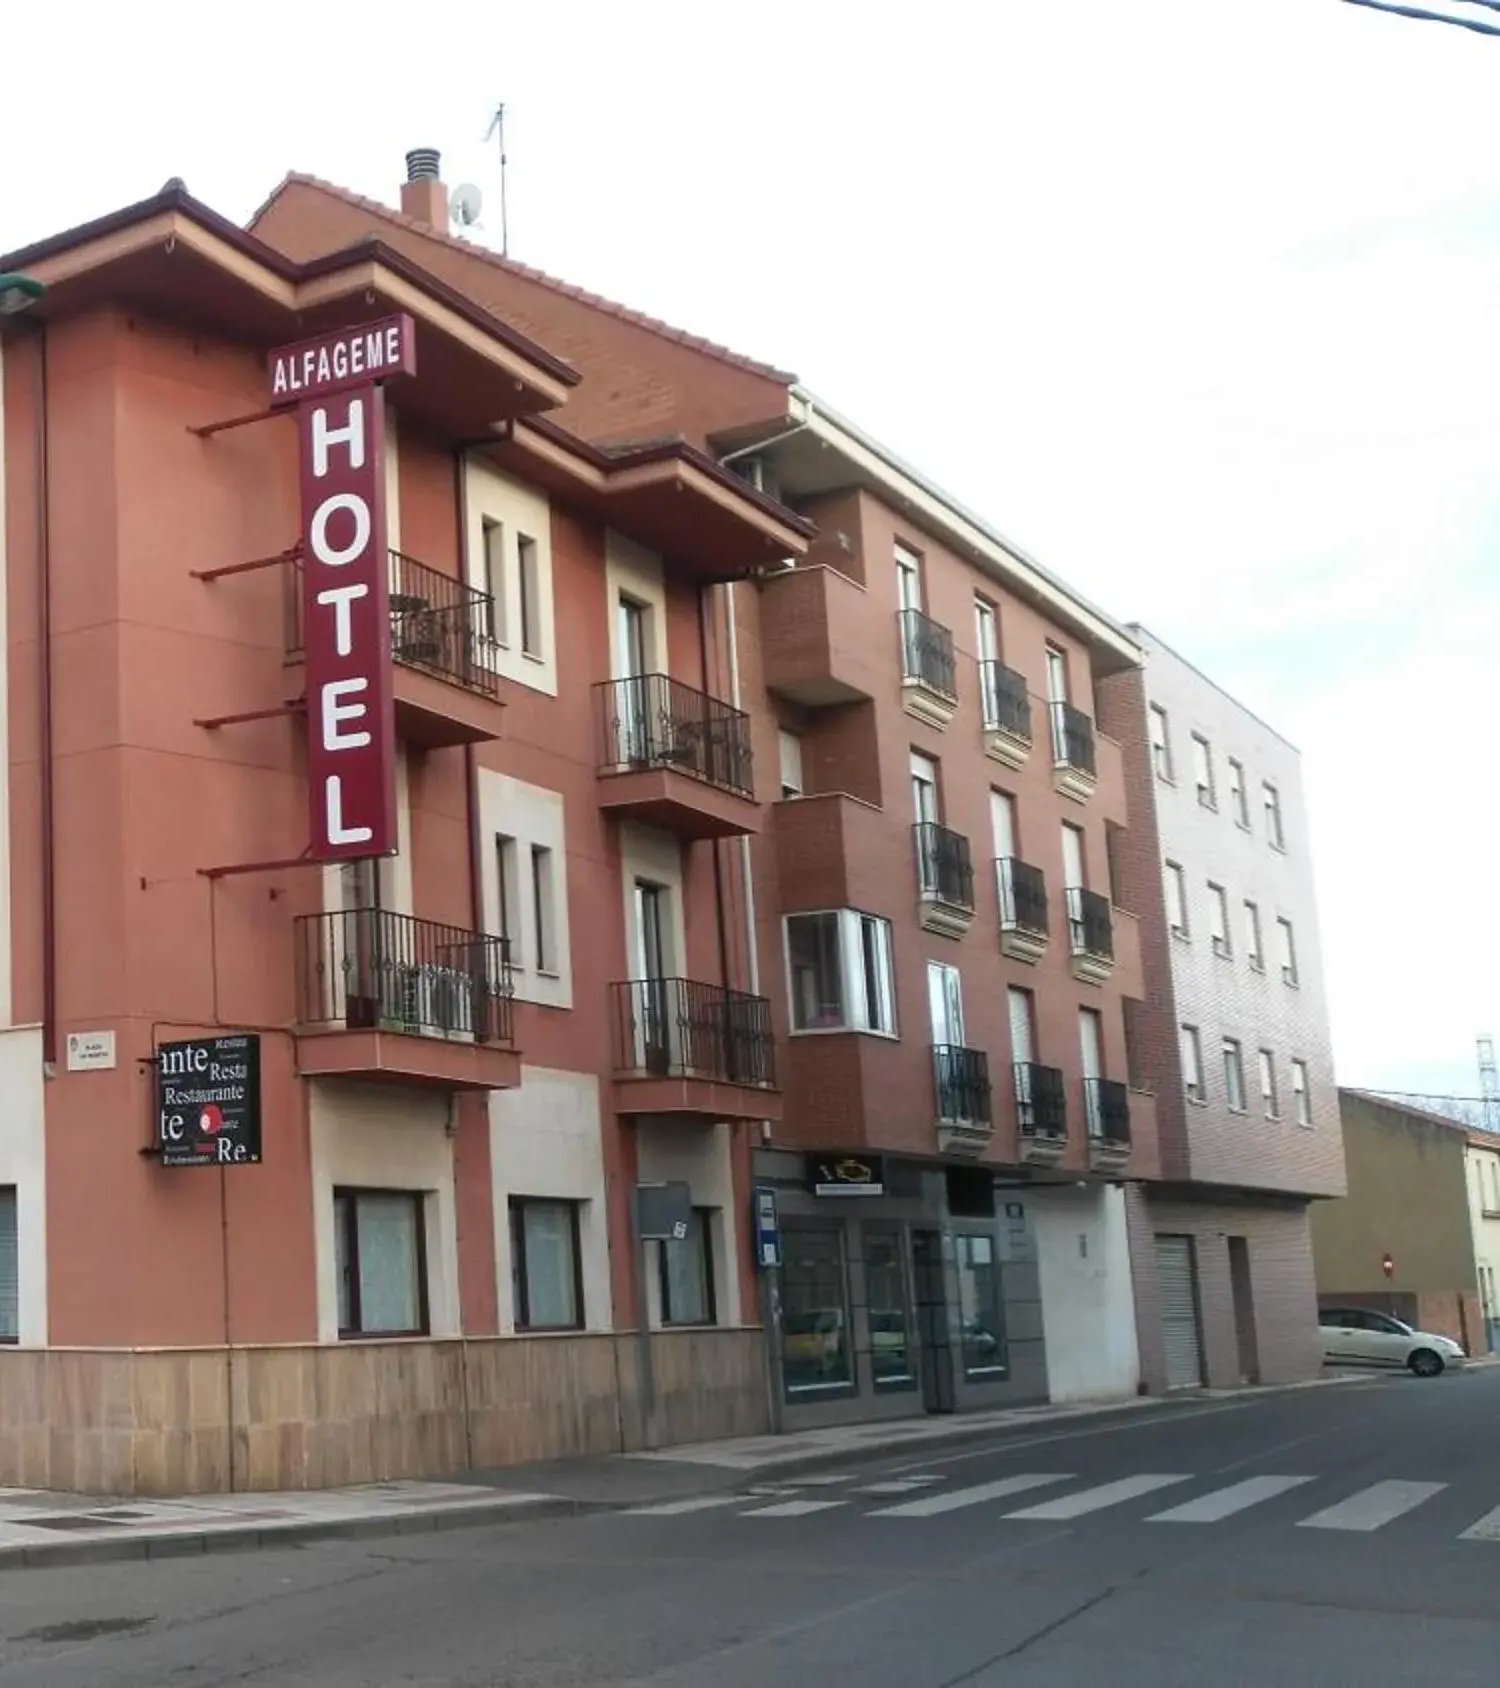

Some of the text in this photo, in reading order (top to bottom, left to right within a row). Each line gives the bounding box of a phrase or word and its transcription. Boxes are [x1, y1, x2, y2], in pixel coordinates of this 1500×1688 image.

[273, 327, 400, 395] ALFAGEME
[309, 399, 373, 846] HOTEL
[164, 1084, 245, 1105] Restaurante
[161, 1109, 185, 1140] te
